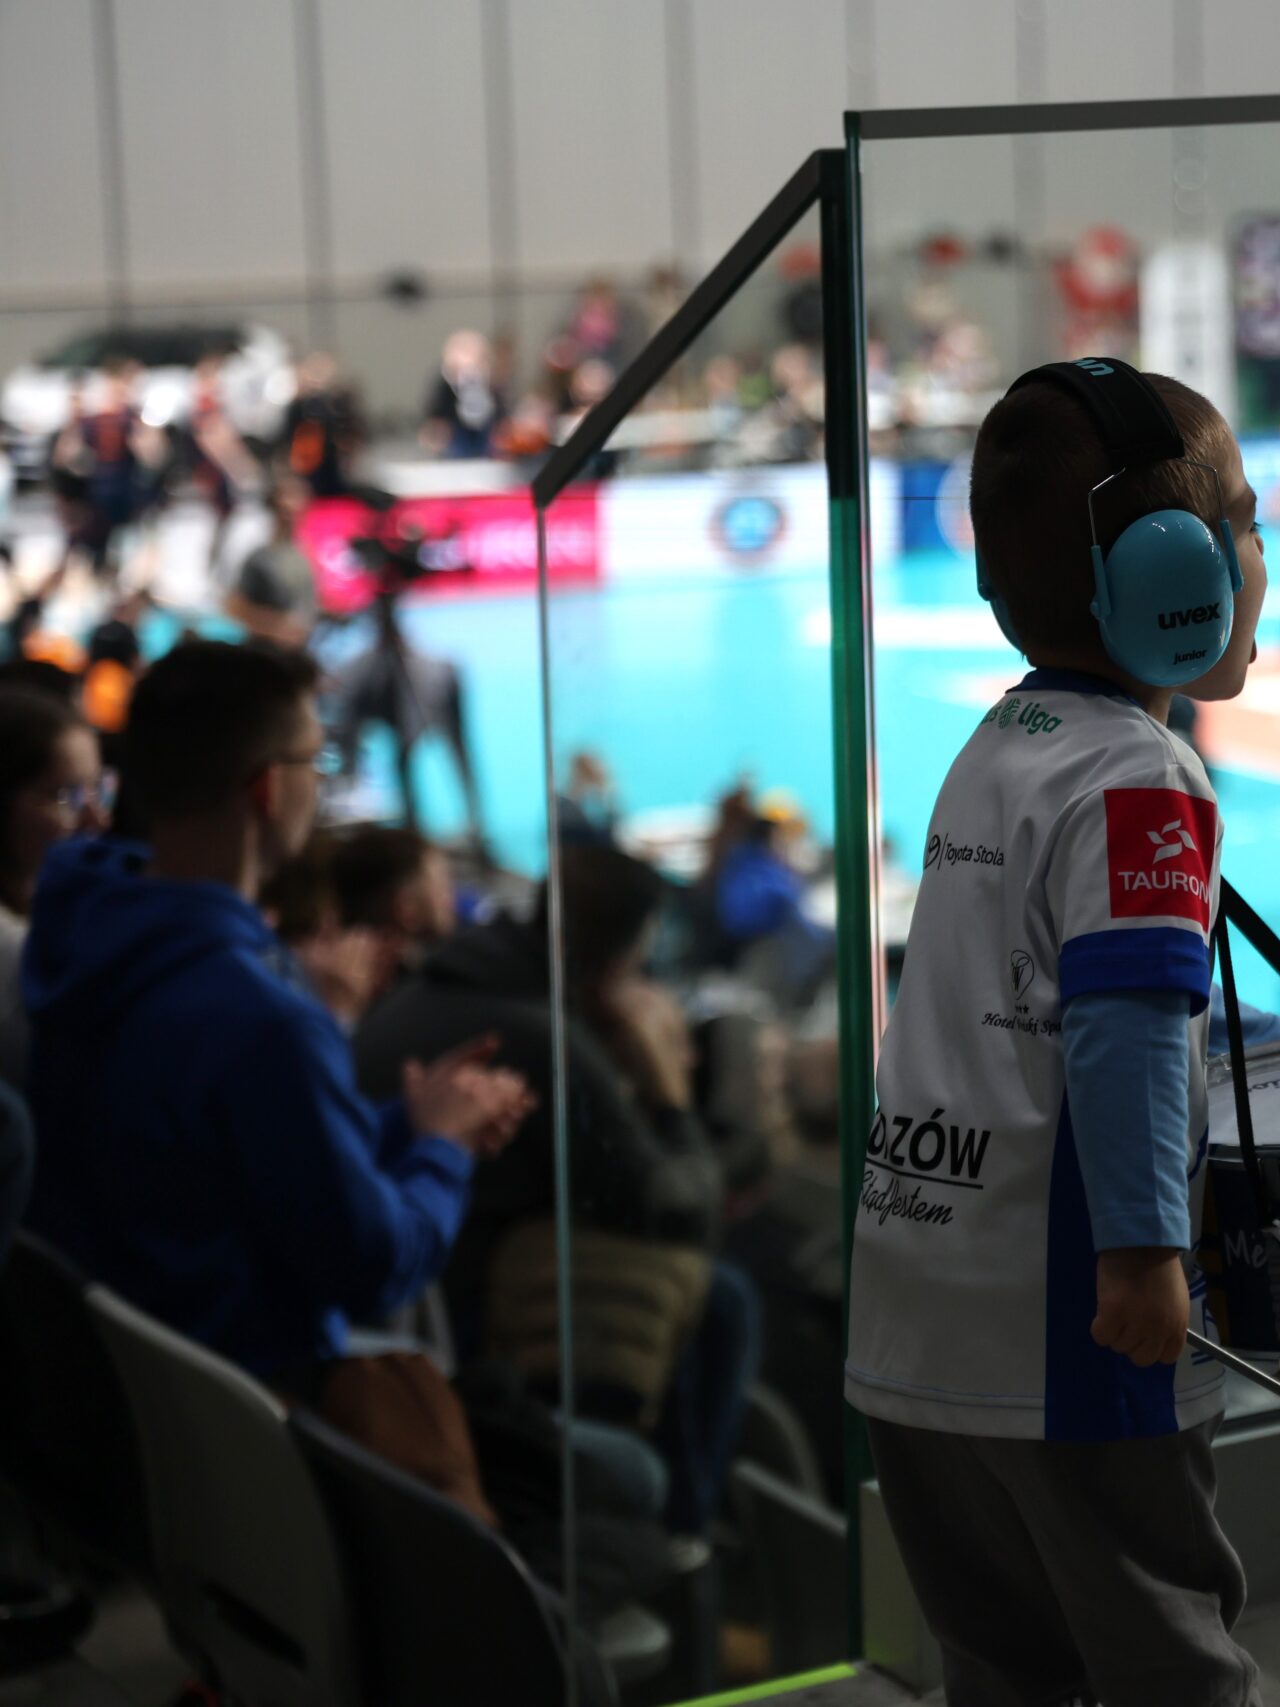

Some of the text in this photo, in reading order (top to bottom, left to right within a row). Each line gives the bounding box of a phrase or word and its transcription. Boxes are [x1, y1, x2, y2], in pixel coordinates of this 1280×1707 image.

[1157, 601, 1222, 630] uvex
[1173, 648, 1207, 665] junior
[945, 842, 973, 866] Toyota
[1117, 871, 1208, 904] TAURON
[981, 1013, 1017, 1030] Hotel
